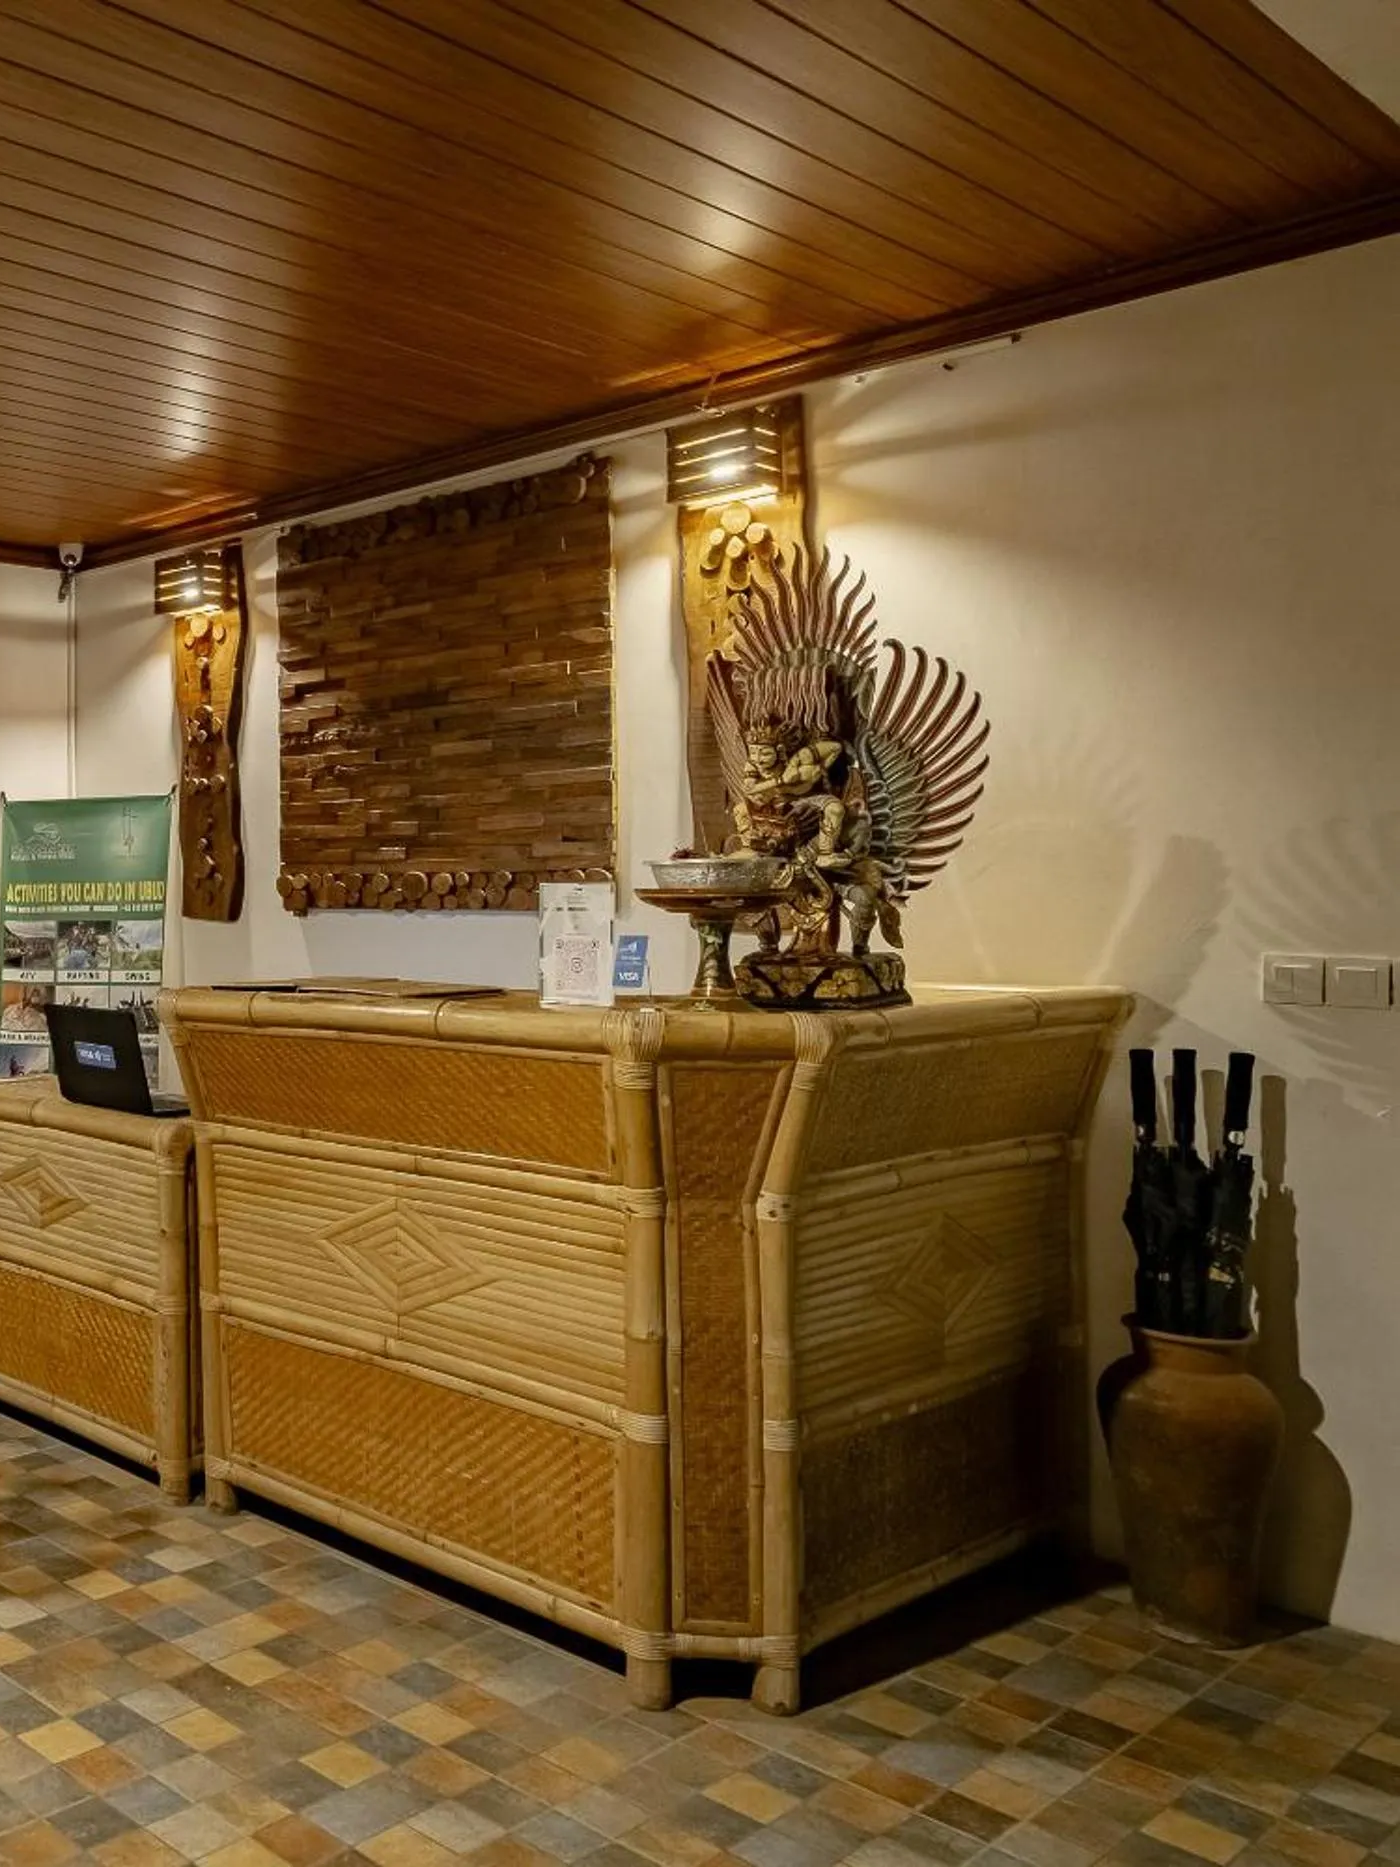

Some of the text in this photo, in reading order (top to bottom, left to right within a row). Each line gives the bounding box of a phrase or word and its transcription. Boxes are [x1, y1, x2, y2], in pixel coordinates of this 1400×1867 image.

[7, 880, 165, 902] ACTIVITIES YOU CAN DO IN UBUD
[618, 971, 640, 981] VISA
